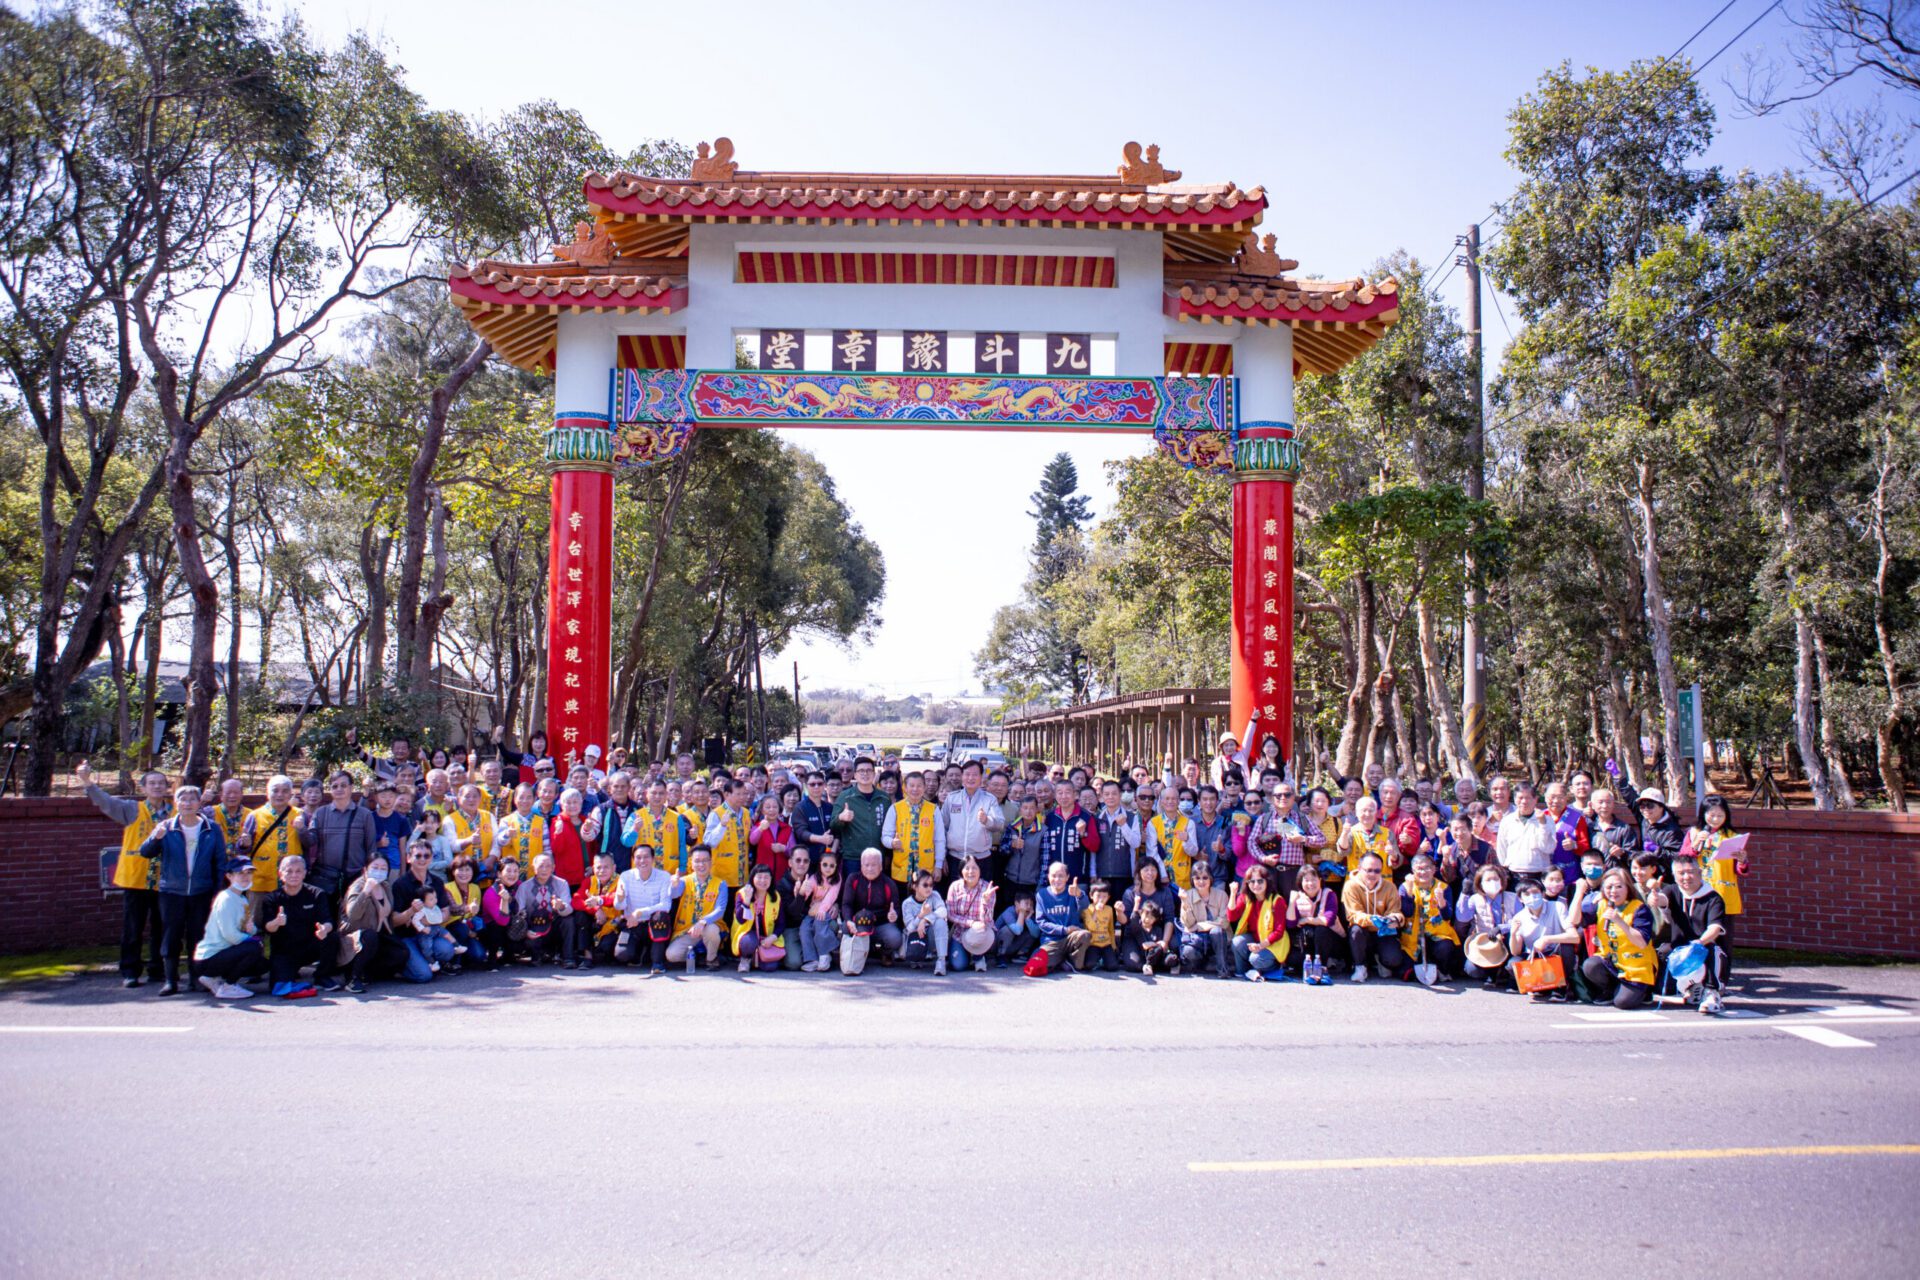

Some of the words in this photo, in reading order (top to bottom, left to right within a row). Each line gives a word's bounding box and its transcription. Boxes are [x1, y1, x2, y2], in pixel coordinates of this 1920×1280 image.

[563, 511, 584, 767] 章台世澤家規祀典行
